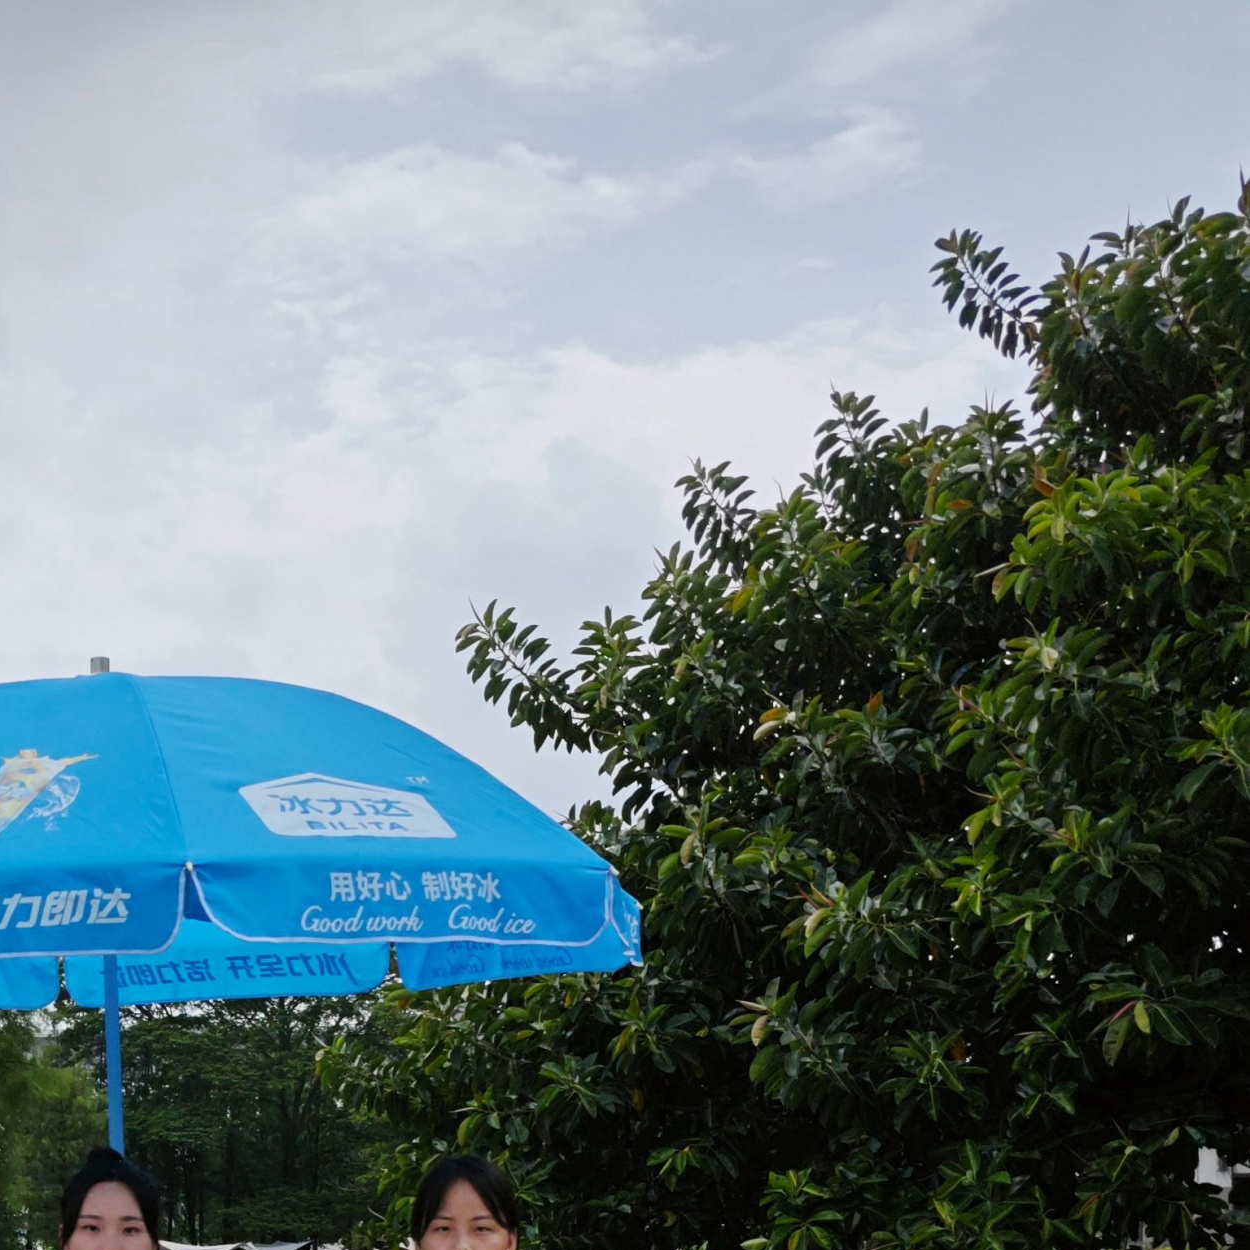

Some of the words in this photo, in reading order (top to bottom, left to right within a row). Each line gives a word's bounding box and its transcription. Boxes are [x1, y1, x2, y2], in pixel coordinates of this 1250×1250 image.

[268, 795, 413, 817] 冰力达
[306, 820, 408, 832] BILITA
[329, 870, 412, 902] 用好心
[421, 870, 501, 903] 制好冰
[300, 904, 364, 933] Good
[366, 905, 424, 932] work
[447, 904, 506, 933] Good
[503, 912, 536, 935] ice
